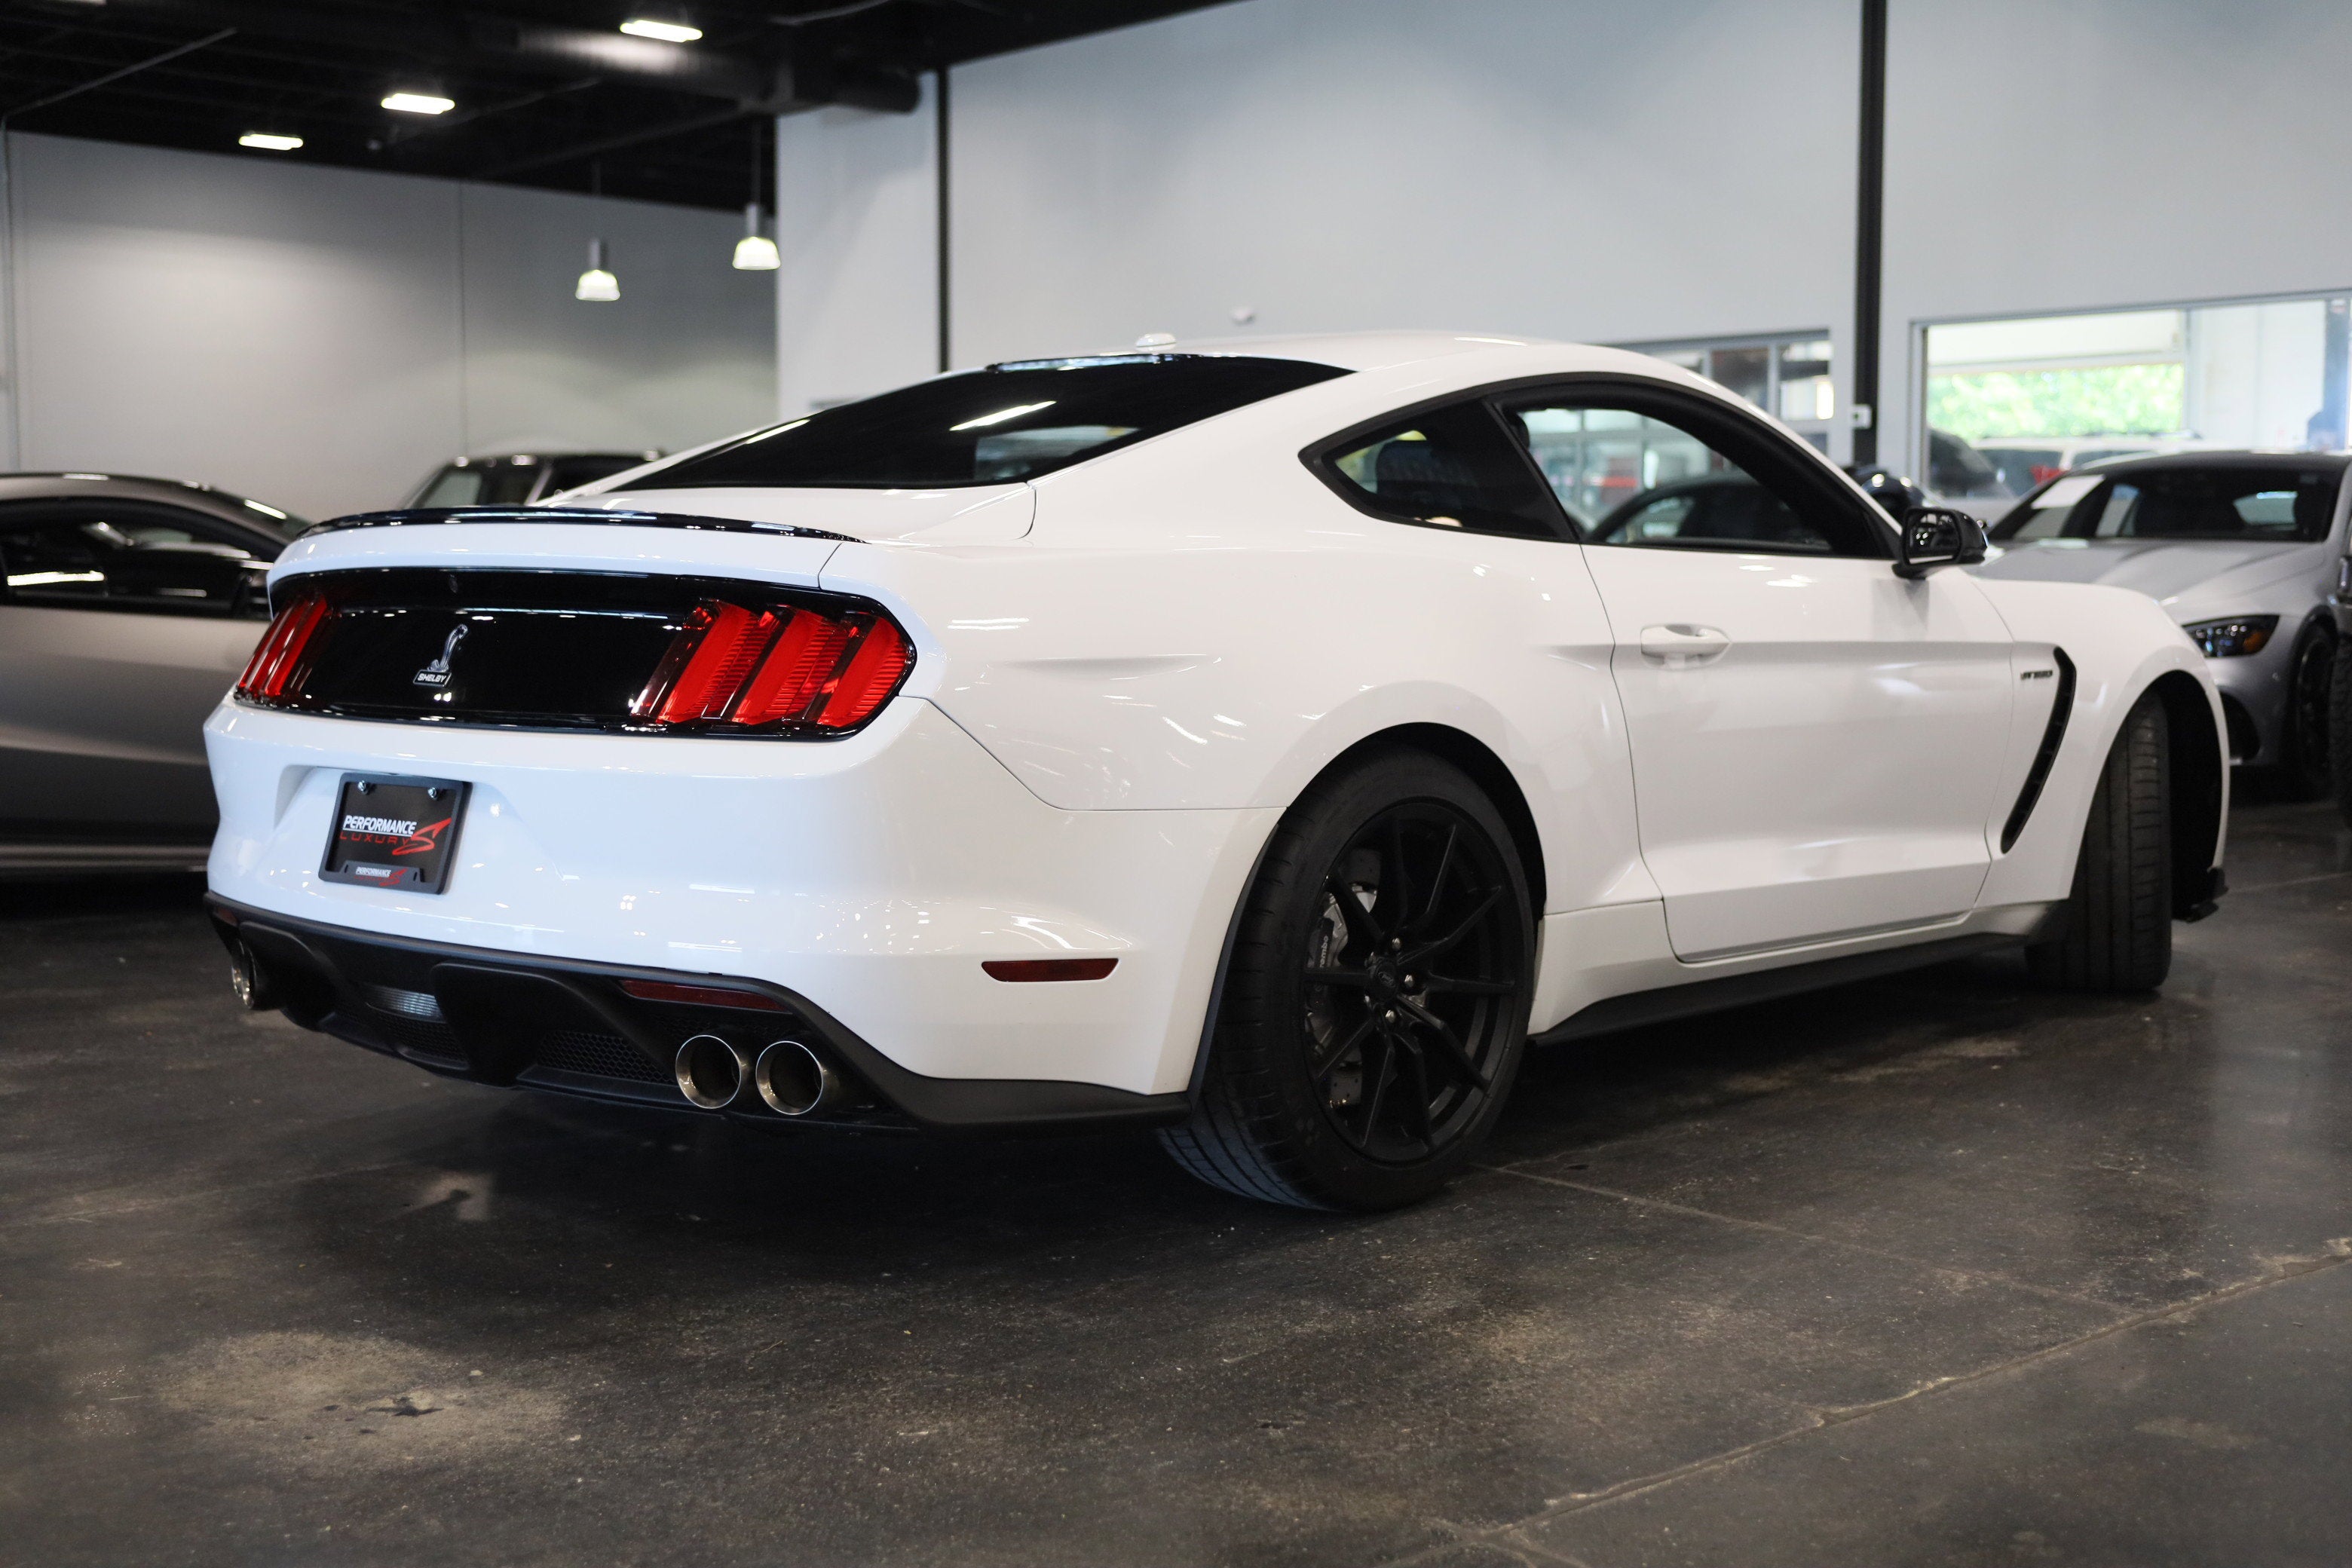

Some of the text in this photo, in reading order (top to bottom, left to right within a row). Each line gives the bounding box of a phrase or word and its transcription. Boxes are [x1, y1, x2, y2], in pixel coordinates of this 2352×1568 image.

[418, 673, 447, 683] SHELBY
[343, 815, 418, 835] PERFORMANCE
[339, 831, 409, 846] LUXURY
[355, 866, 392, 877] PERFORMANCE
[1319, 935, 1329, 968] rembo
